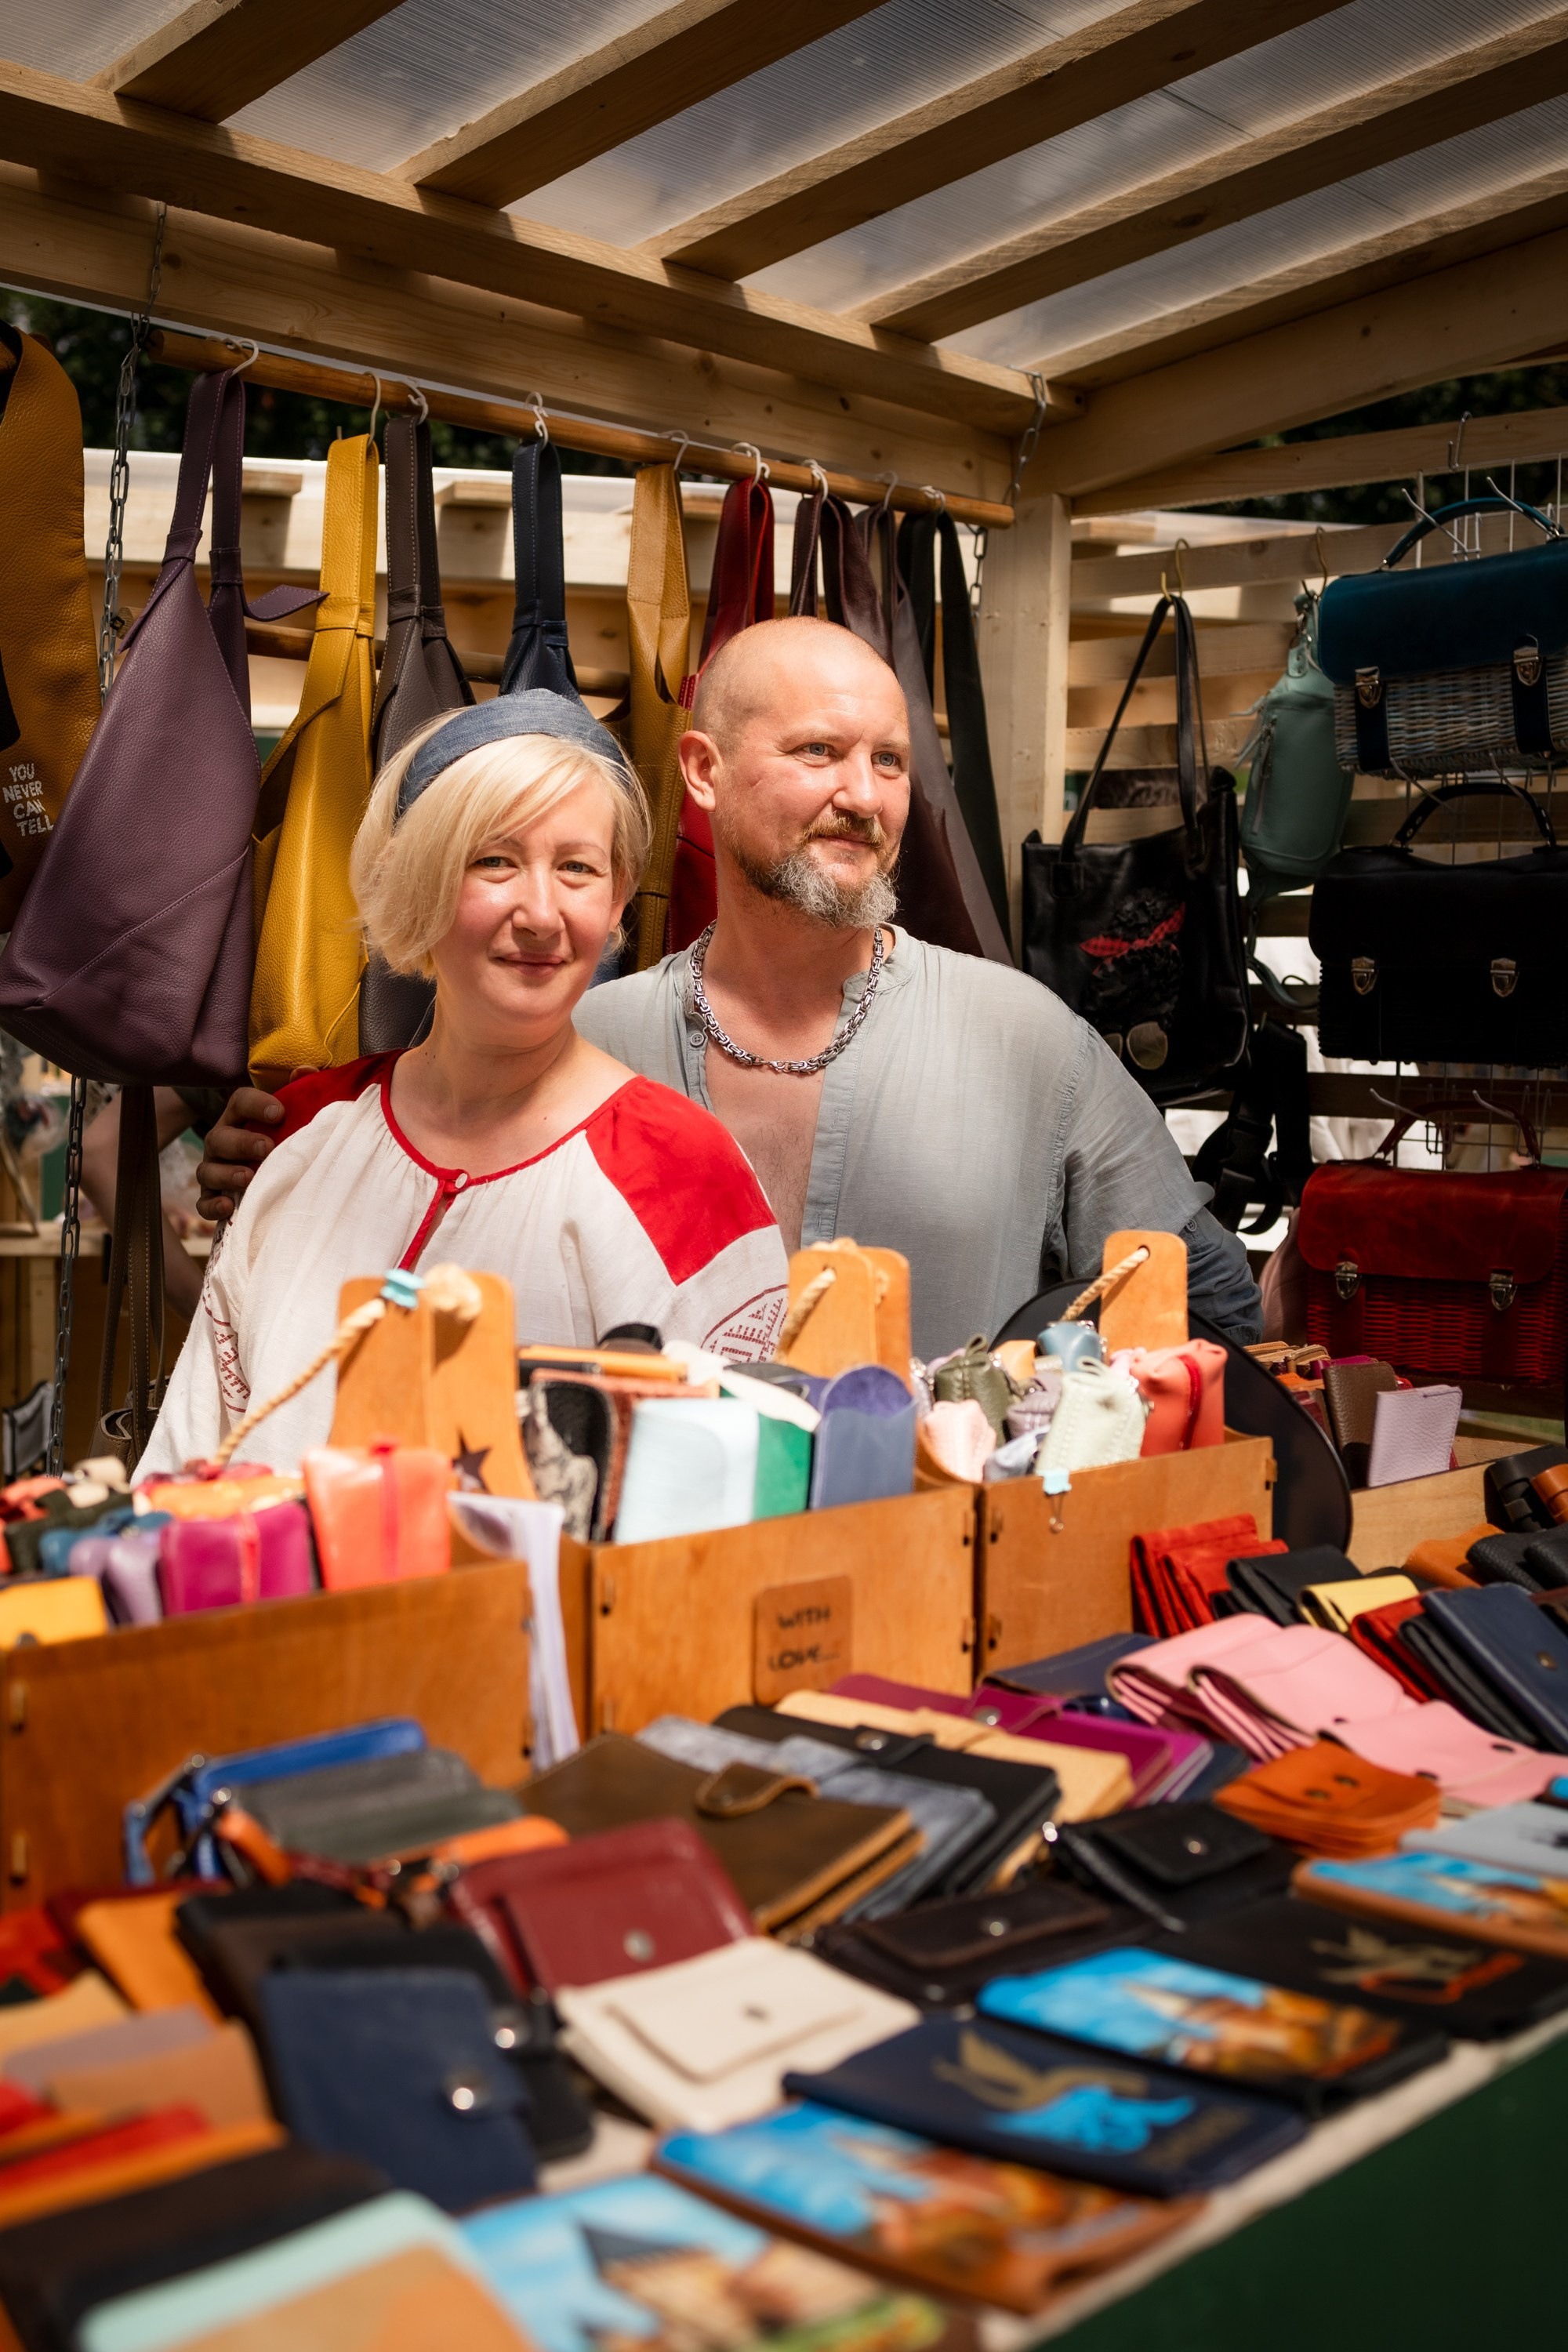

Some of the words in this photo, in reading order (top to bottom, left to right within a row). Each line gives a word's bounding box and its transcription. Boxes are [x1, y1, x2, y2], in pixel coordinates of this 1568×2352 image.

[9, 763, 35, 782] YOU
[2, 781, 44, 804] NEVER
[13, 799, 46, 820] CAN
[16, 815, 54, 837] TELL
[777, 1605, 831, 1630] WITH
